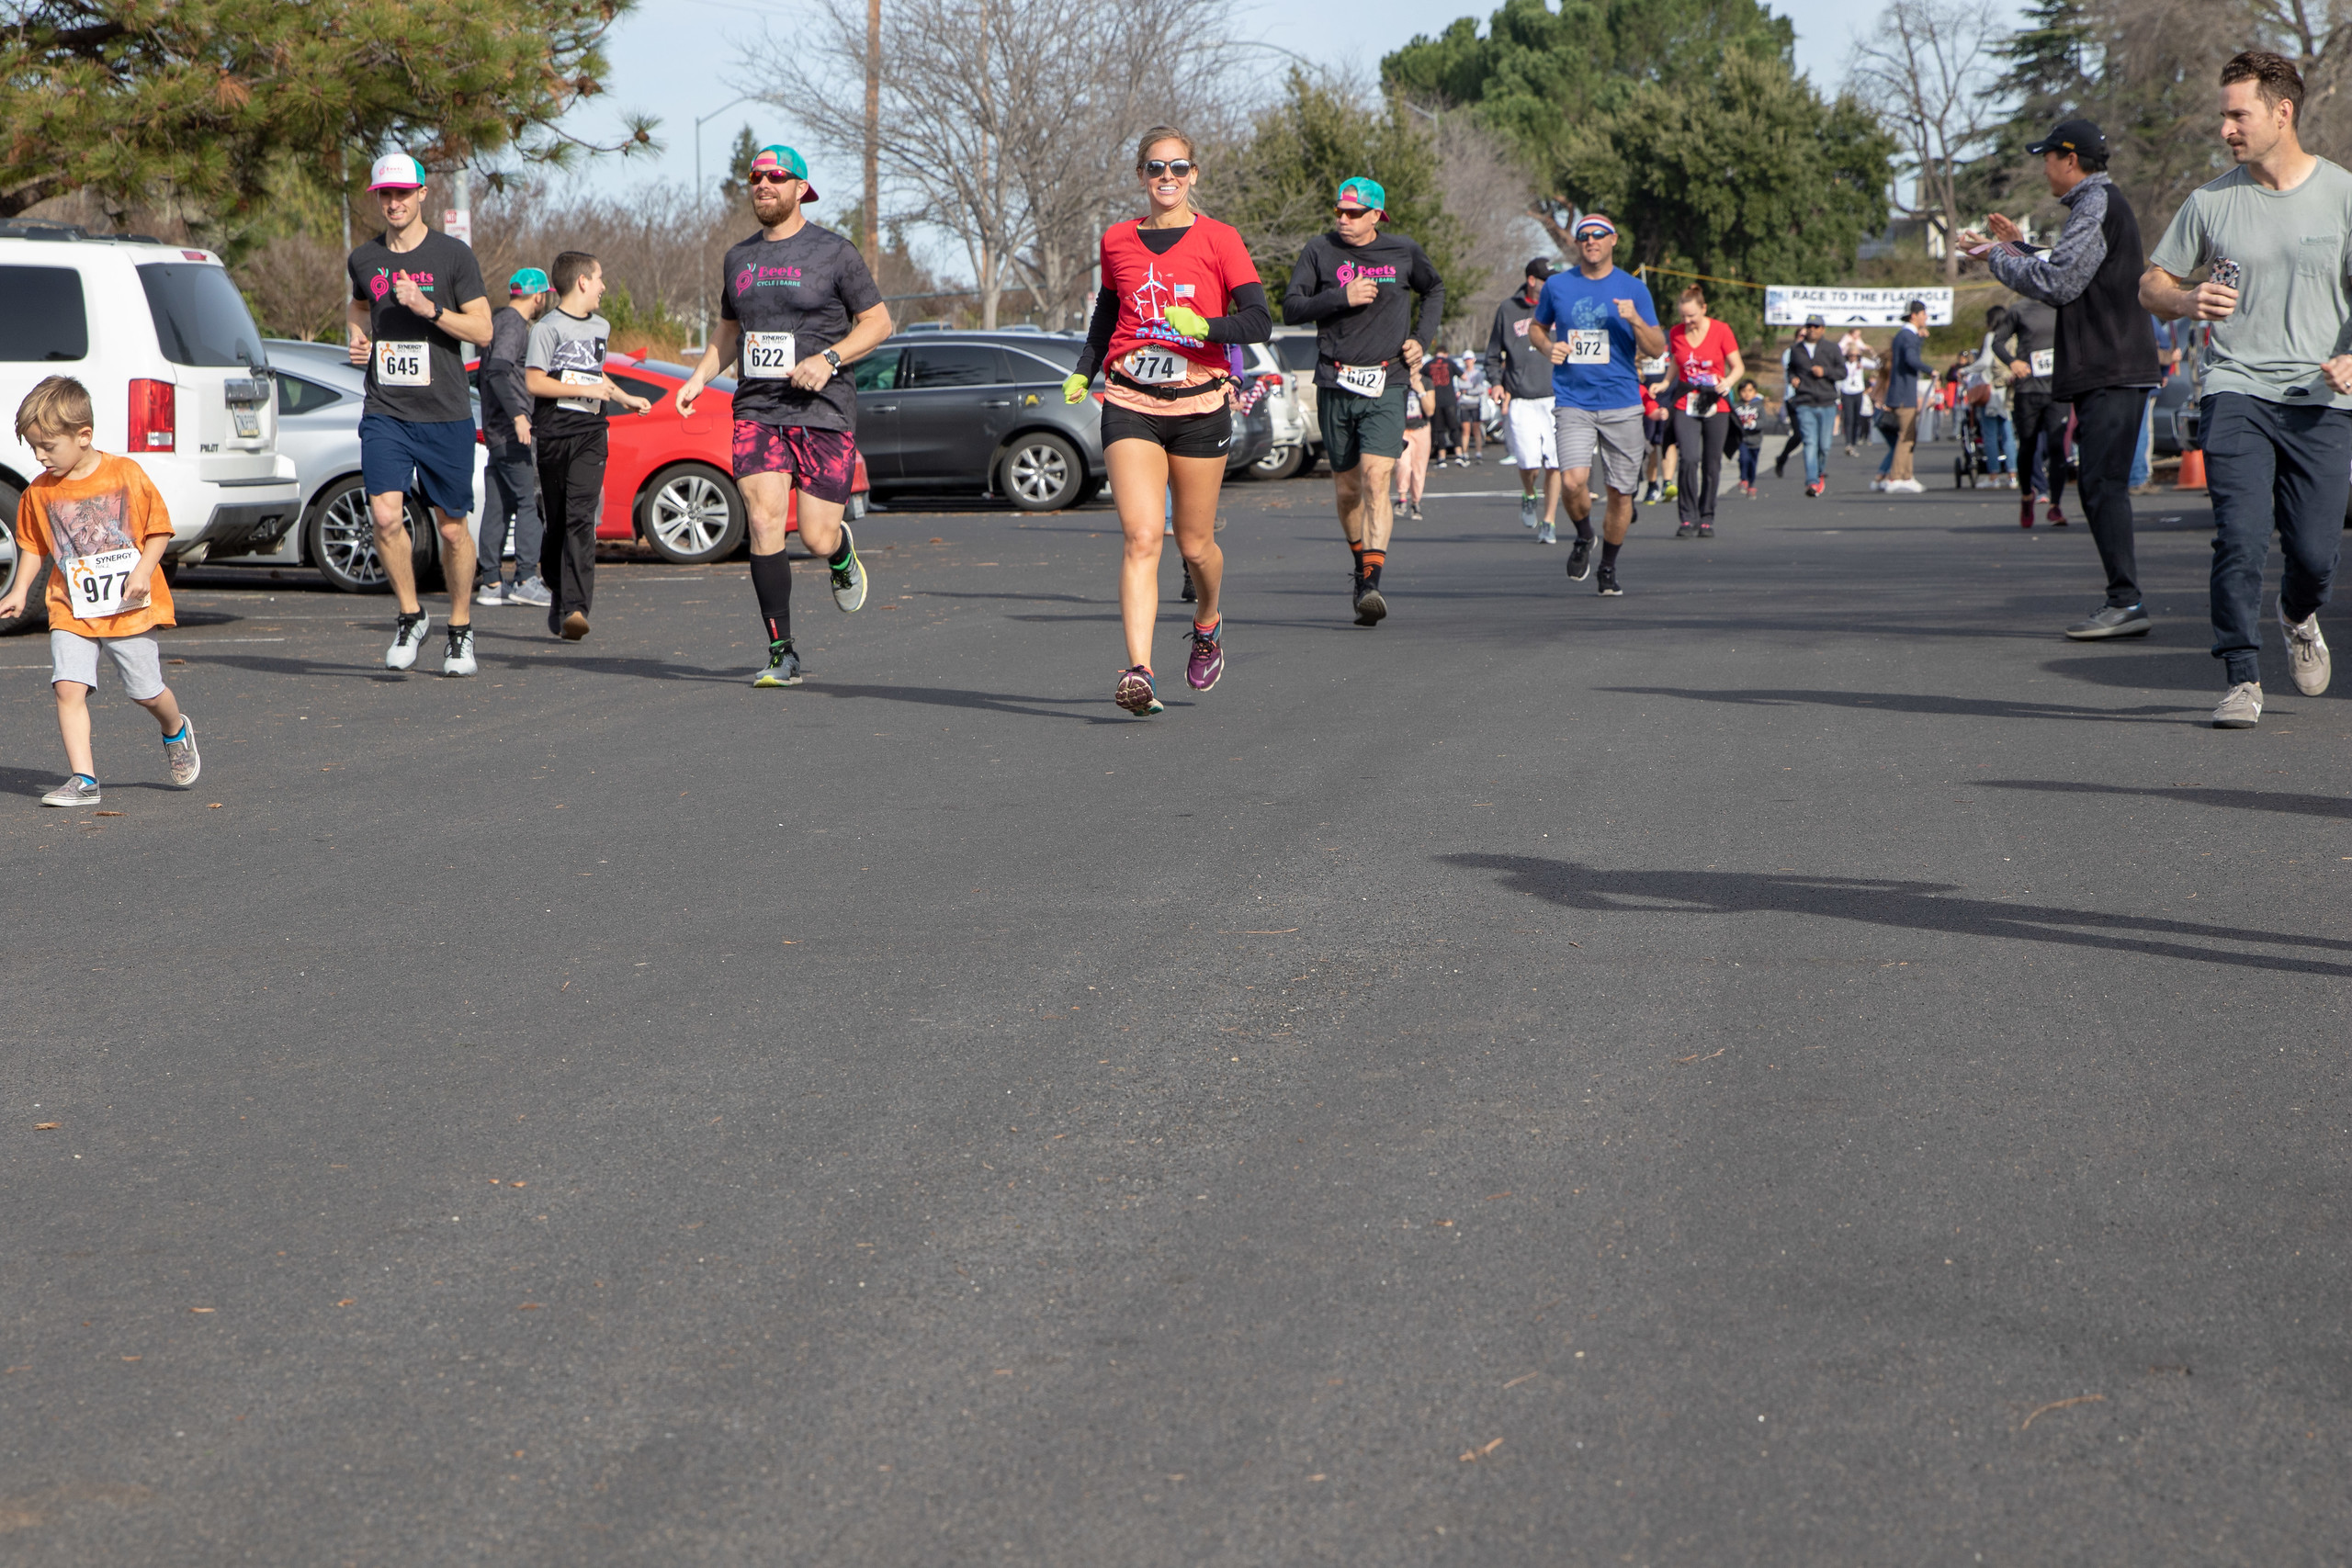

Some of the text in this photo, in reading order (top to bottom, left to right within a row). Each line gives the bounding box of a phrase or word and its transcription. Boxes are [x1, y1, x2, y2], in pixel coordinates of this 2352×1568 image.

[392, 271, 435, 284] Bets
[758, 266, 802, 277] Beets
[1357, 265, 1396, 276] Beets
[779, 279, 801, 288] BARRE
[1792, 290, 1826, 301] RACE
[1831, 292, 1849, 301] TO
[1853, 292, 1877, 302] THE
[1882, 290, 1950, 302] FLAGPOLE
[1576, 341, 1601, 355] 972
[752, 347, 785, 367] 622
[387, 356, 419, 376] 645
[1134, 356, 1174, 378] 774
[1347, 370, 1375, 388] 602
[199, 444, 220, 453] PILOT
[96, 551, 133, 565] SYNERGY
[83, 570, 130, 604] 977
